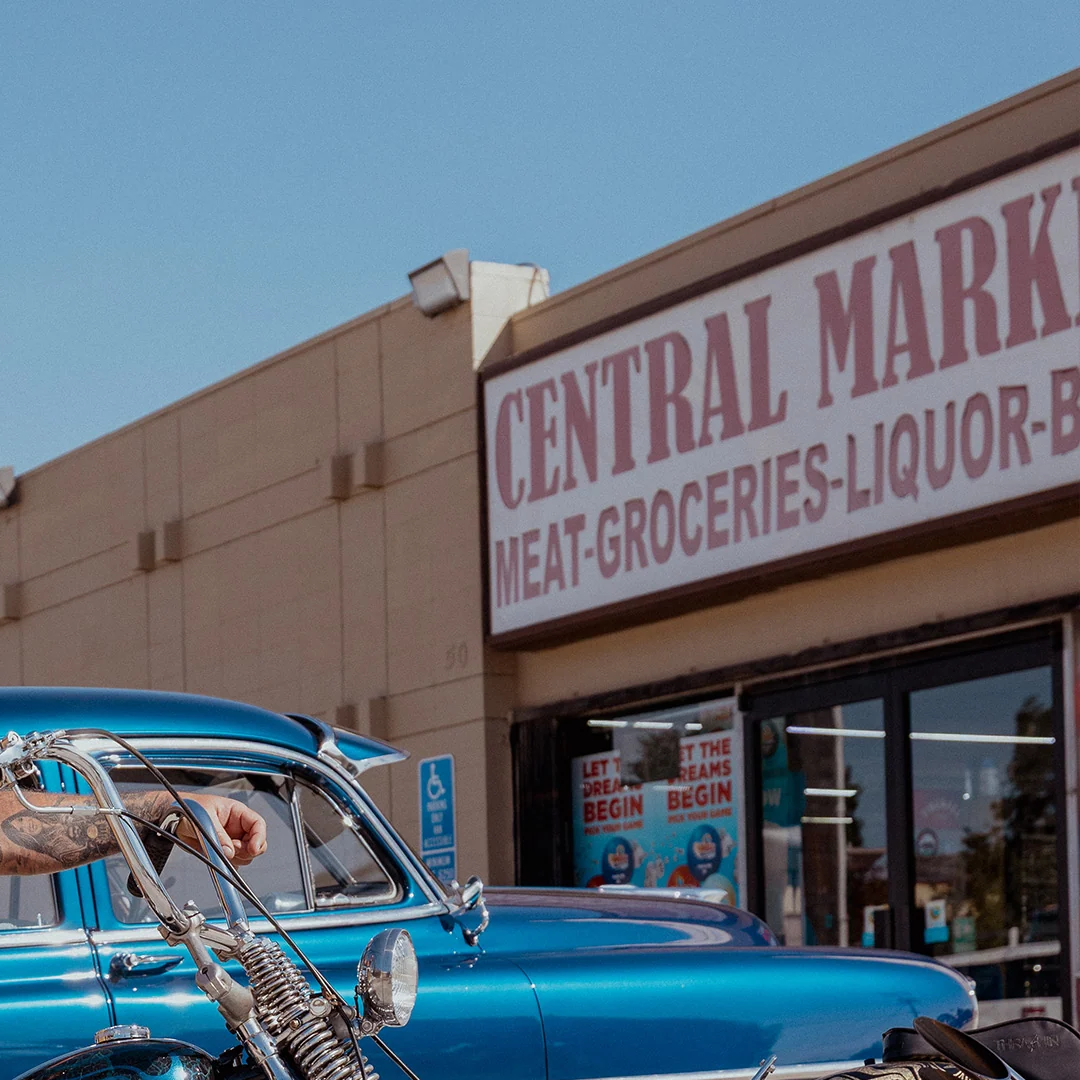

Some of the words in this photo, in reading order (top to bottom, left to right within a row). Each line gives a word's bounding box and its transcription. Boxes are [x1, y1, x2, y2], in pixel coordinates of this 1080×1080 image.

[495, 294, 789, 511] CENTRAL
[814, 175, 1080, 409] MARK
[679, 743, 695, 762] ET
[699, 737, 732, 760] THE
[583, 758, 609, 779] LET
[667, 758, 732, 784] REAMS
[583, 777, 644, 799] DREA
[667, 781, 733, 812] BEGIN
[583, 794, 644, 824] BEGIN
